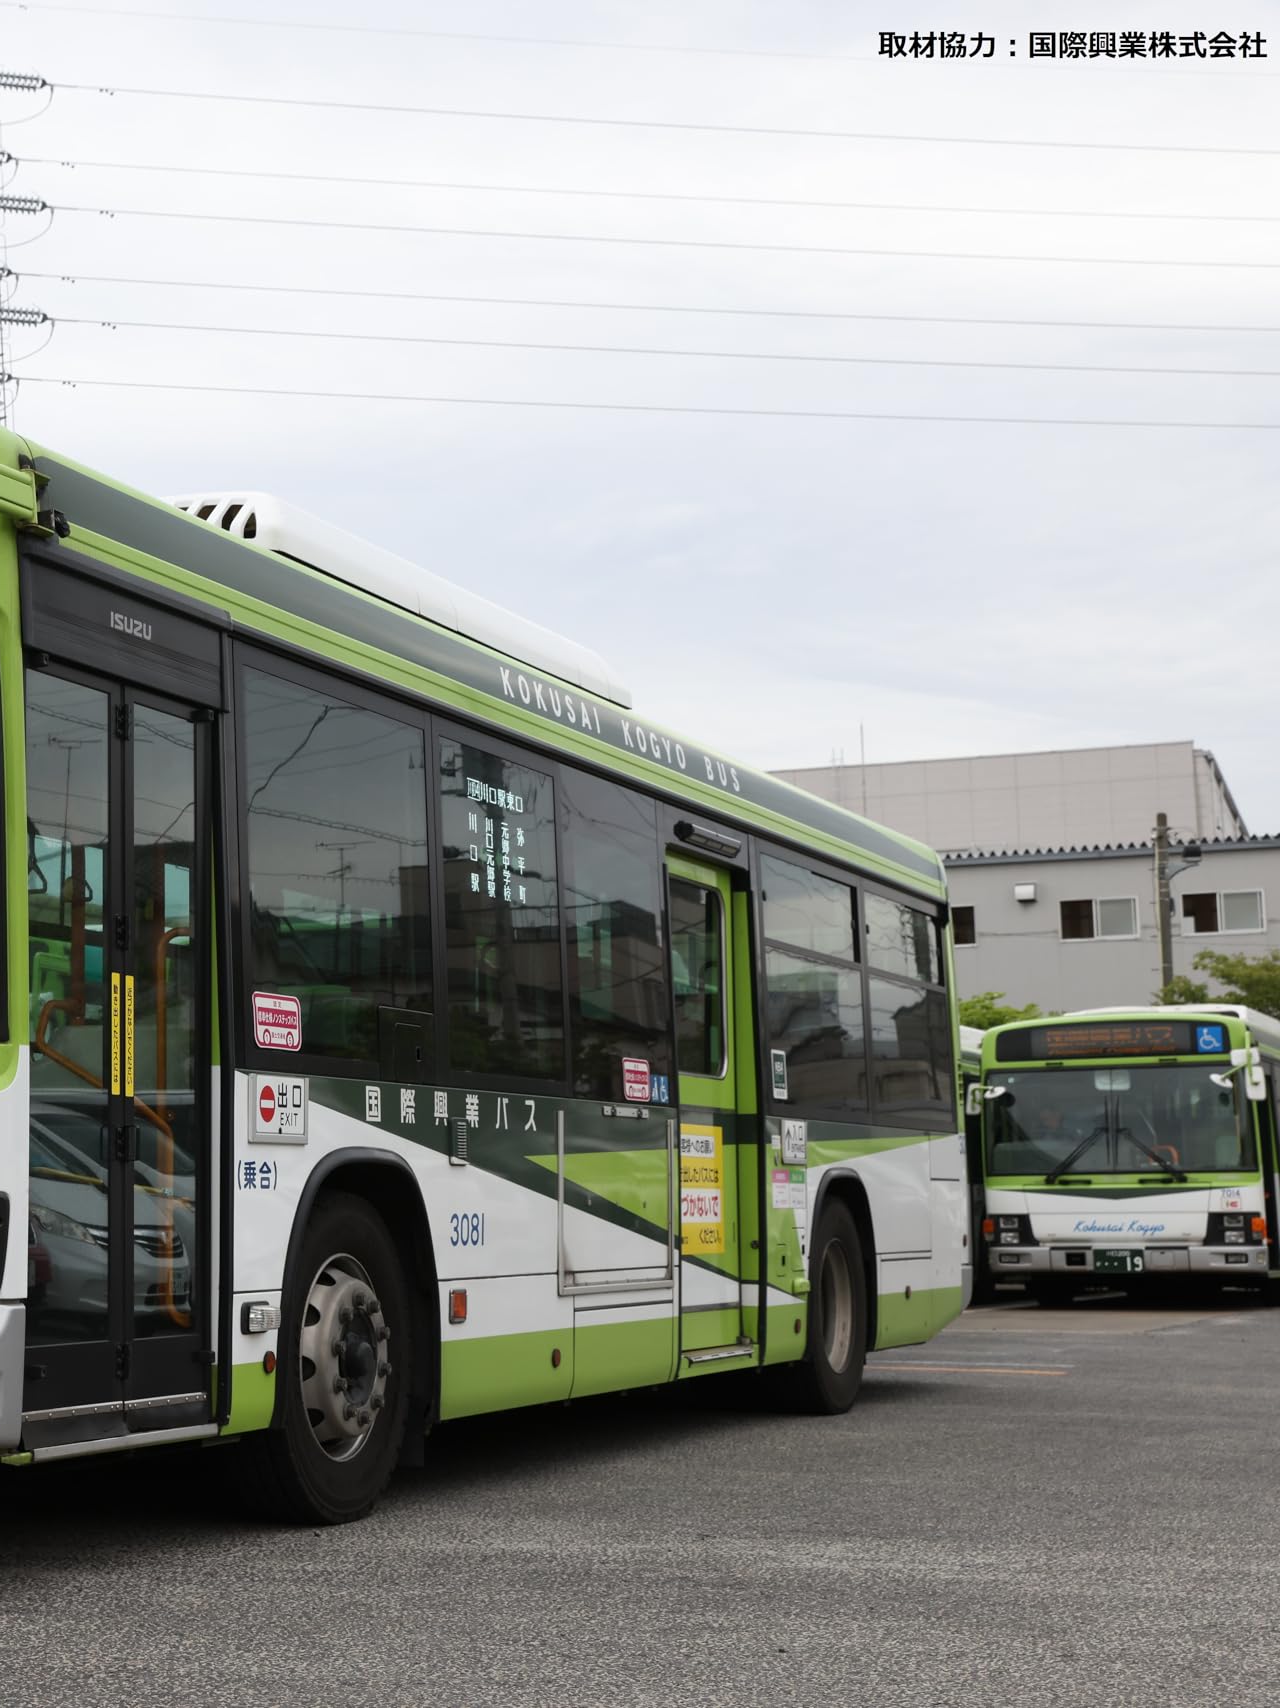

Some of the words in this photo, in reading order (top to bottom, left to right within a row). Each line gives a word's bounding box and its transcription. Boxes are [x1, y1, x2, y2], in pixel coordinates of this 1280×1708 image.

[110, 611, 151, 640] ISUZU
[499, 666, 601, 734] KOKUSAI
[622, 719, 686, 769] KOGYO
[704, 756, 740, 792] BUS
[278, 1083, 301, 1108] 出口
[365, 1085, 536, 1132] 国際興業バス
[280, 1112, 298, 1126] EXIT
[450, 1213, 484, 1246] 3081
[1073, 1220, 1123, 1234] Kokusai
[1126, 1221, 1165, 1236] Kogyo
